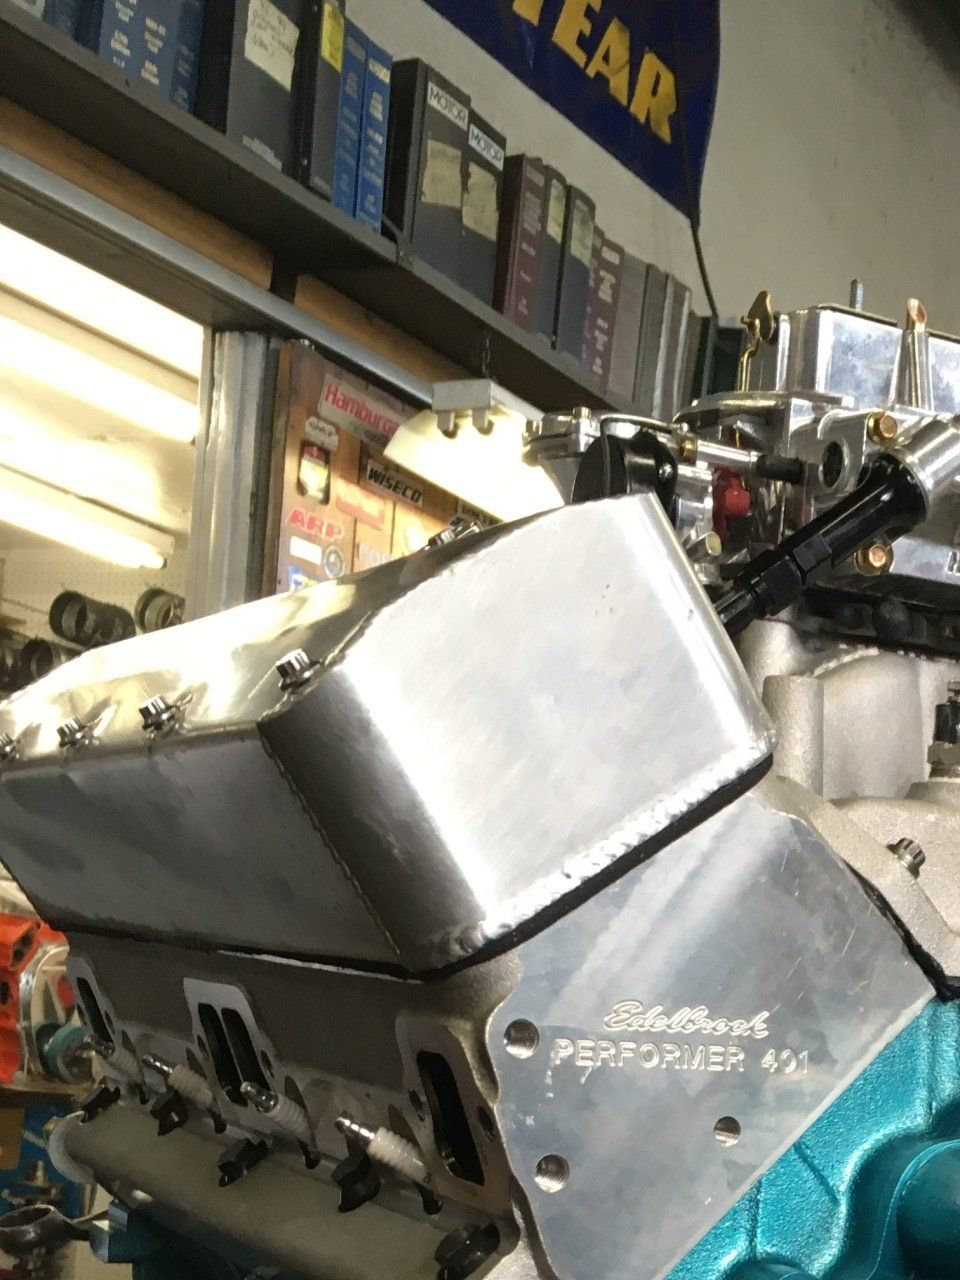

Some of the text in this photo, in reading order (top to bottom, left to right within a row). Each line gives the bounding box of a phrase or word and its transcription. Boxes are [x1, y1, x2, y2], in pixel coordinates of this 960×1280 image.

[430, 86, 466, 124] MOTOR
[471, 129, 503, 164] MOTOR
[367, 466, 423, 503] WISECO
[287, 508, 342, 541] ARP
[602, 998, 770, 1040] Edelbrock
[552, 1037, 810, 1075] PERFORMER 401
